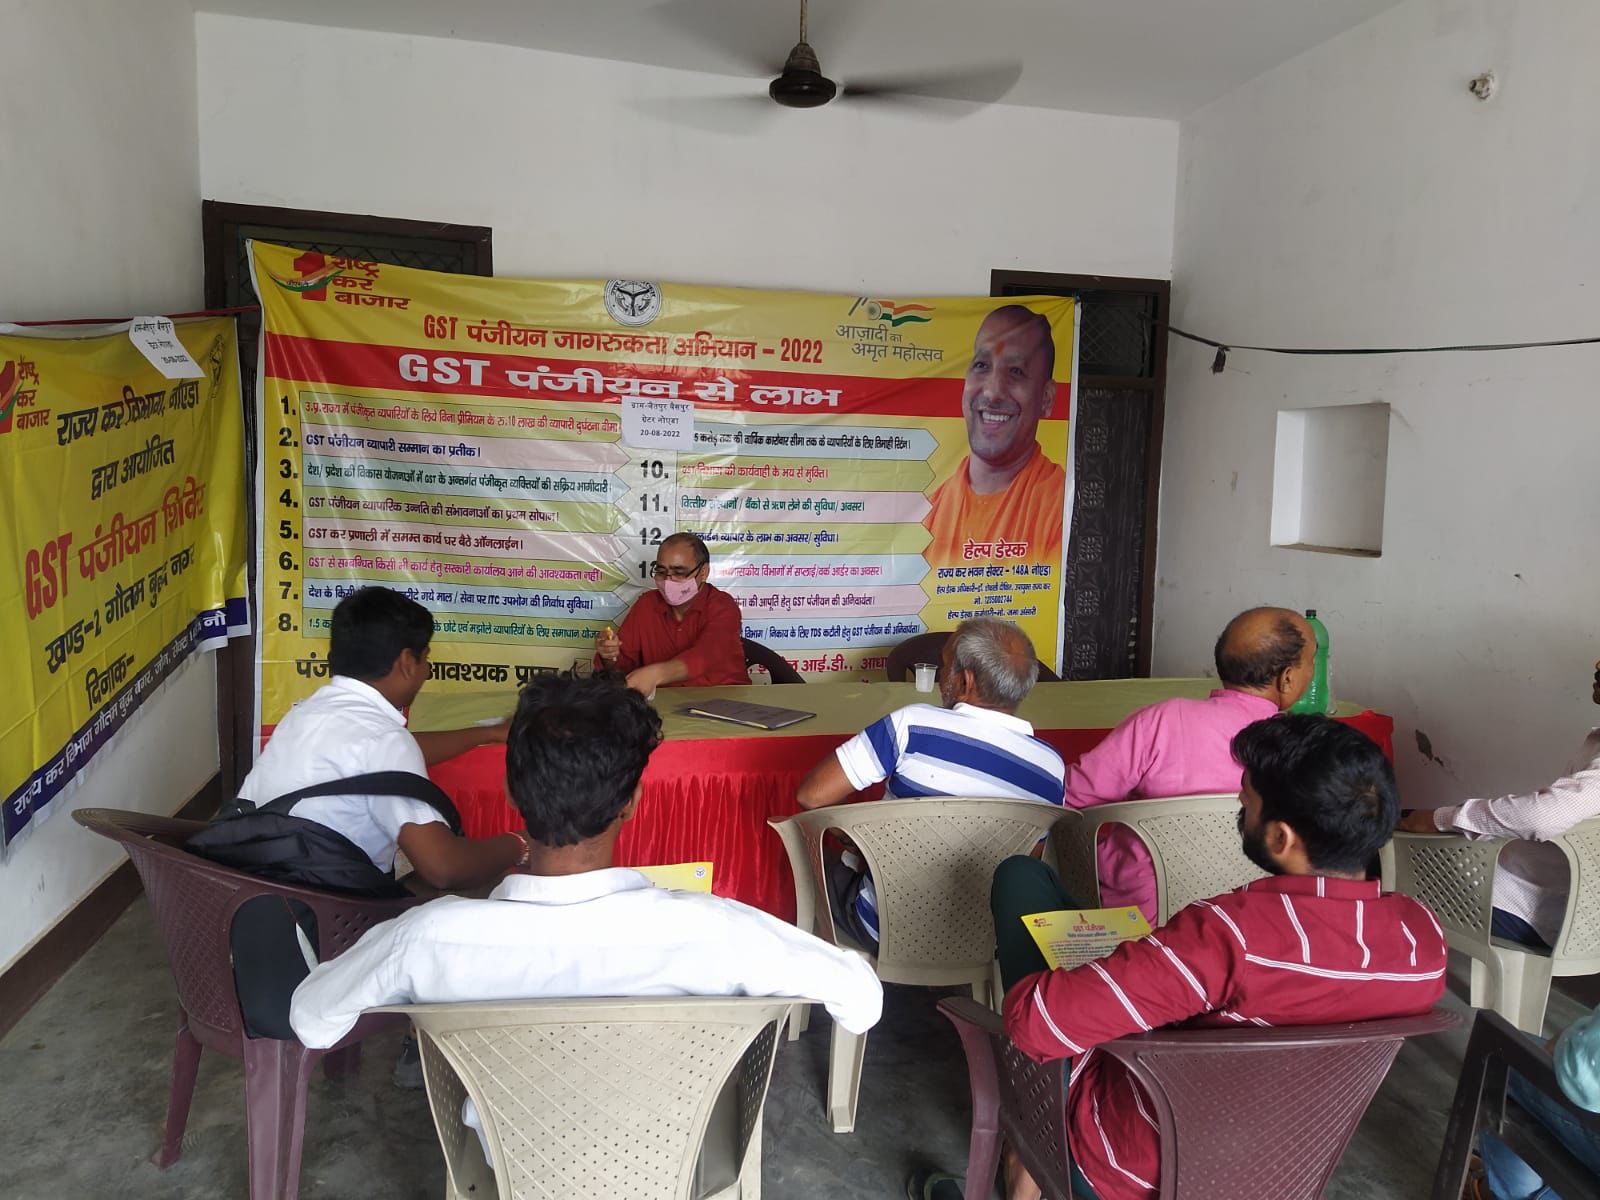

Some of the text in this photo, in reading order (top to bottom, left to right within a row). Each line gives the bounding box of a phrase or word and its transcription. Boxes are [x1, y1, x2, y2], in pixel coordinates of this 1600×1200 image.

[331, 276, 374, 291] कर
[334, 291, 411, 310] बाजार
[424, 314, 459, 340] GST
[466, 319, 548, 347] पंजीयन
[674, 331, 757, 360] अभियान
[780, 337, 823, 364] 2022
[890, 333, 902, 343] का
[852, 342, 944, 362] अमृत महोत्सव
[398, 354, 842, 407] GST पंजीयन से लाभ
[16, 389, 38, 408] कर
[281, 395, 296, 415] 1.
[518, 417, 535, 428] लाख
[537, 415, 548, 428] की
[57, 407, 99, 446] राज्य
[101, 399, 125, 432] कर
[279, 427, 445, 455] 2. GST पंजीयन व्यापारी सम्मान का
[640, 429, 680, 438] 20-08-2022
[92, 434, 175, 500] द्वारा आयोजित
[279, 459, 298, 479] 3.
[325, 463, 342, 478] प्रदेश
[344, 463, 355, 477] की
[357, 464, 383, 480] विकास
[425, 475, 437, 484] GST
[438, 472, 446, 485] के
[479, 473, 508, 492] पंजीकृत
[541, 477, 551, 491] की
[640, 460, 669, 479] 10.
[280, 489, 298, 508] 4.
[308, 496, 324, 508] GST
[329, 495, 360, 510] पंजीयन
[363, 498, 402, 512] व्यापारिक
[431, 503, 442, 517] की
[491, 506, 503, 520] का
[640, 493, 669, 512] 11.
[763, 498, 770, 510] से
[802, 498, 812, 511] की
[279, 520, 298, 540] 5.
[308, 528, 327, 539] GST
[330, 529, 346, 539] कर
[348, 527, 377, 542] प्रणाली
[380, 529, 391, 542] में
[423, 531, 442, 545] कार्य
[746, 530, 754, 542] के
[963, 539, 1027, 559] हेल्प डेस्क
[25, 532, 73, 620] GST
[78, 510, 159, 581] पंजीयन
[279, 551, 298, 571] 6.
[308, 557, 324, 568] GST
[328, 556, 336, 568] से
[375, 557, 396, 571] किसी
[410, 558, 428, 572] कार्य
[526, 565, 537, 578] की
[279, 581, 298, 600] 7.
[308, 585, 322, 598] देश
[324, 586, 333, 598] के
[488, 596, 500, 605] ITC
[530, 594, 540, 607] की
[793, 596, 806, 606] GST
[807, 594, 830, 607] पंजीयन
[831, 594, 841, 606] की
[278, 613, 298, 632] 8.
[309, 618, 320, 628] 1.5
[810, 628, 821, 637] TDS
[852, 627, 863, 637] GST
